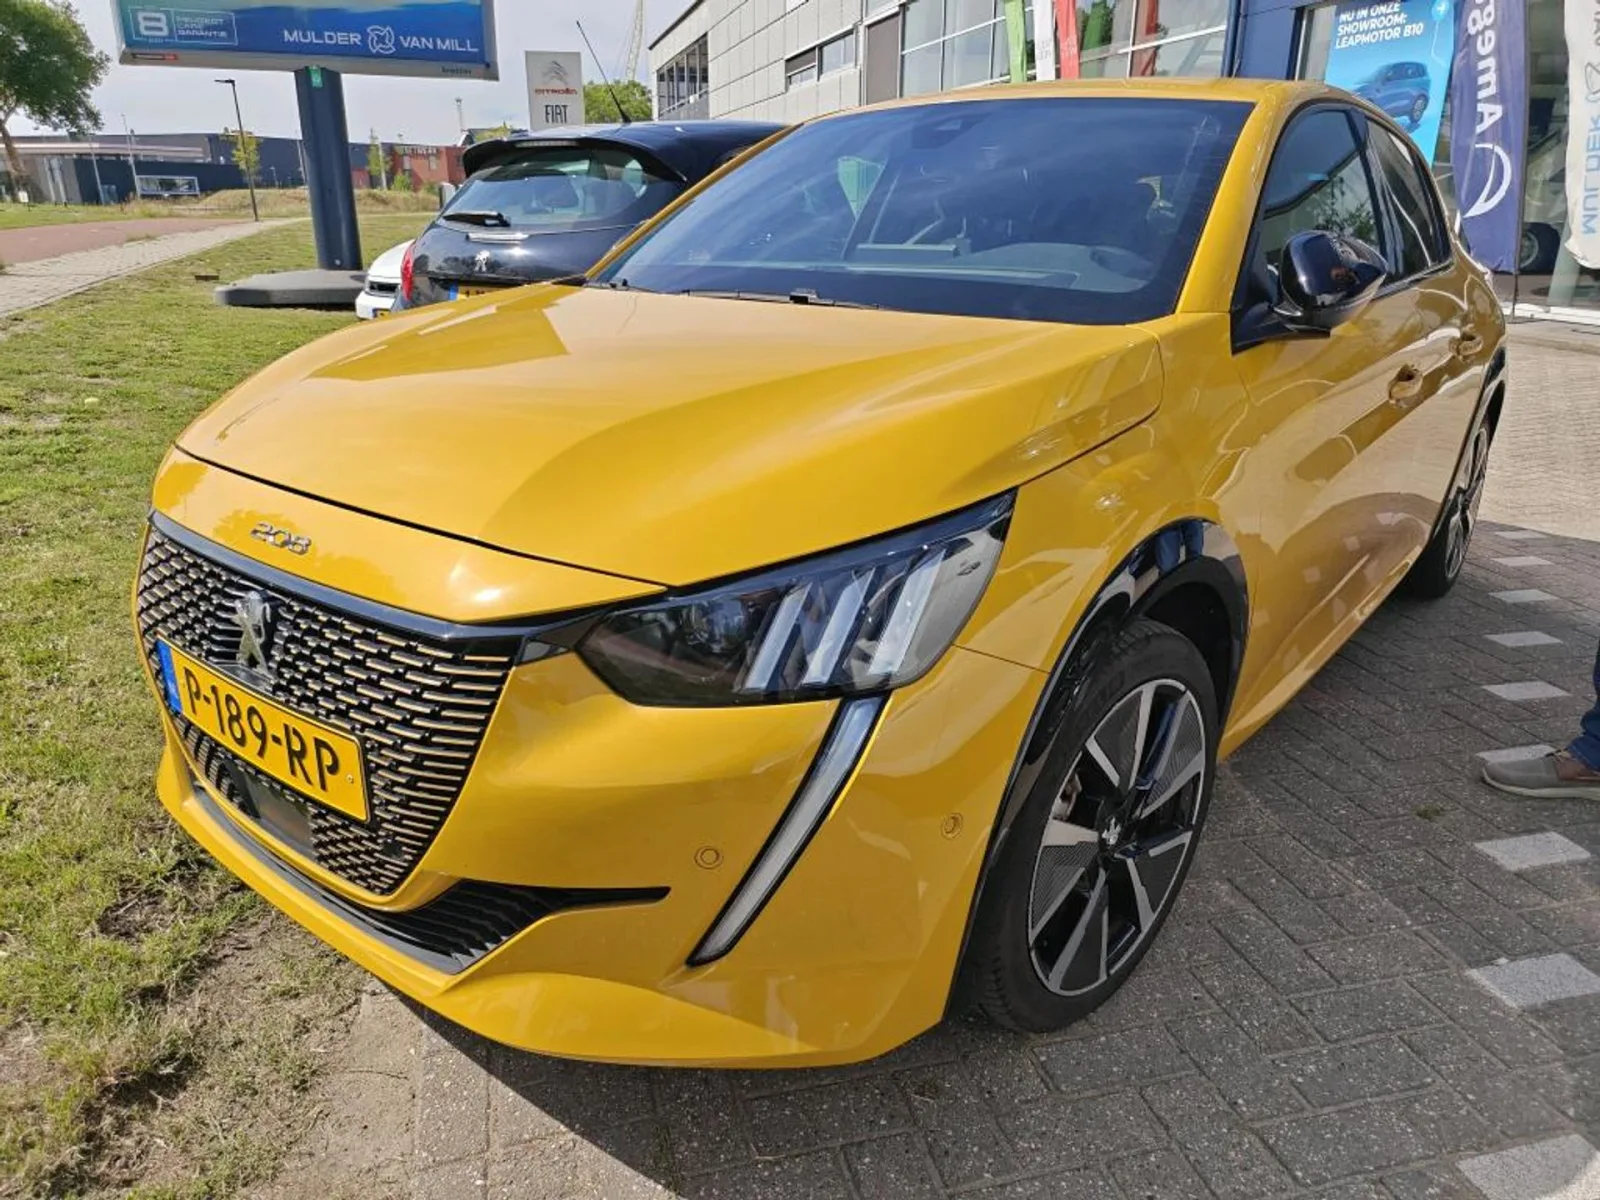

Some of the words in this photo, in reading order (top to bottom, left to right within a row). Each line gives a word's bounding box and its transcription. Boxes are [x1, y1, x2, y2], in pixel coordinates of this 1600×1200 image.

[1339, 10, 1355, 22] NU
[1356, 7, 1369, 20] IN
[1370, 3, 1401, 17] ONZE
[1335, 27, 1401, 49] LEAPMOTOR
[1403, 22, 1424, 37] B10
[1337, 14, 1408, 36] SHOWROOM:
[283, 29, 362, 45] MULDER
[400, 36, 434, 49] VAN
[436, 38, 479, 52] MILL
[544, 104, 569, 124] FIAT
[250, 522, 312, 556] 208
[183, 667, 340, 793] P-189-RP
